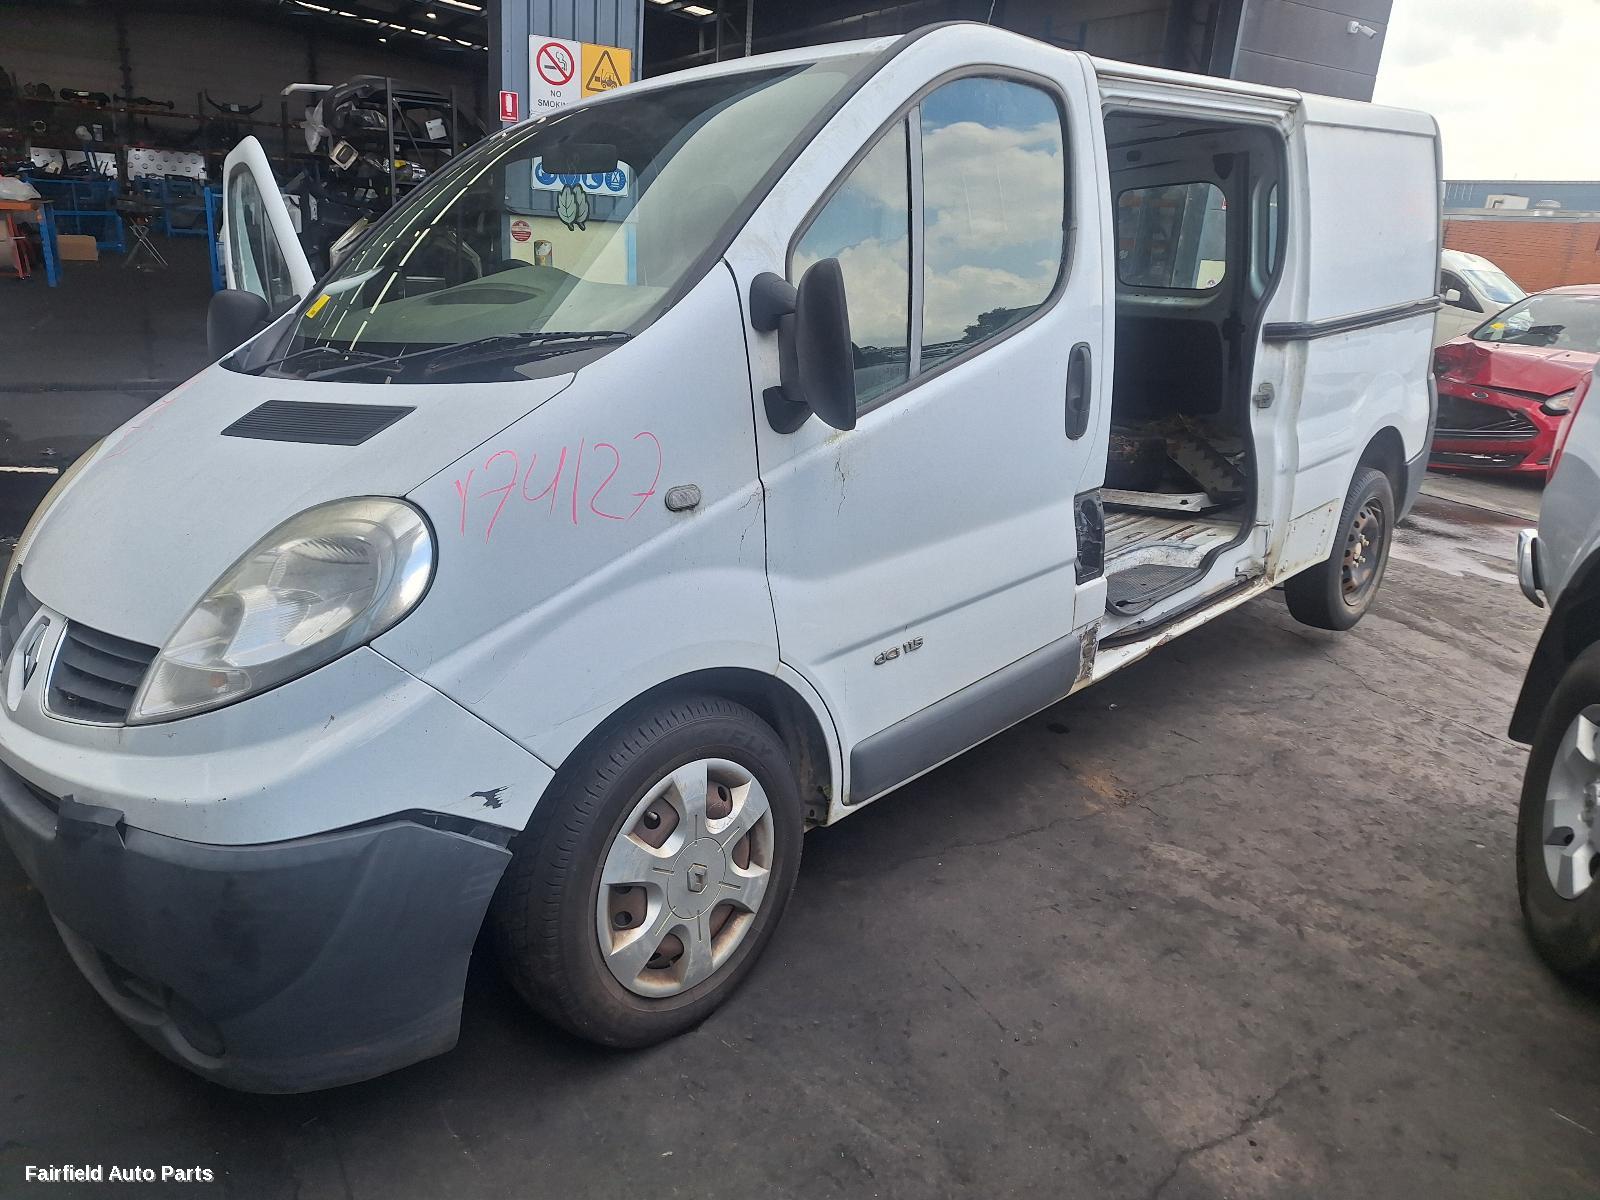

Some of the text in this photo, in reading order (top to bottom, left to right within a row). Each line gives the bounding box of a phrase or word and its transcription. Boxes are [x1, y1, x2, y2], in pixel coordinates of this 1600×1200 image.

[550, 90, 562, 98] NO
[537, 98, 569, 108] SMOKI
[902, 636, 924, 654] 115
